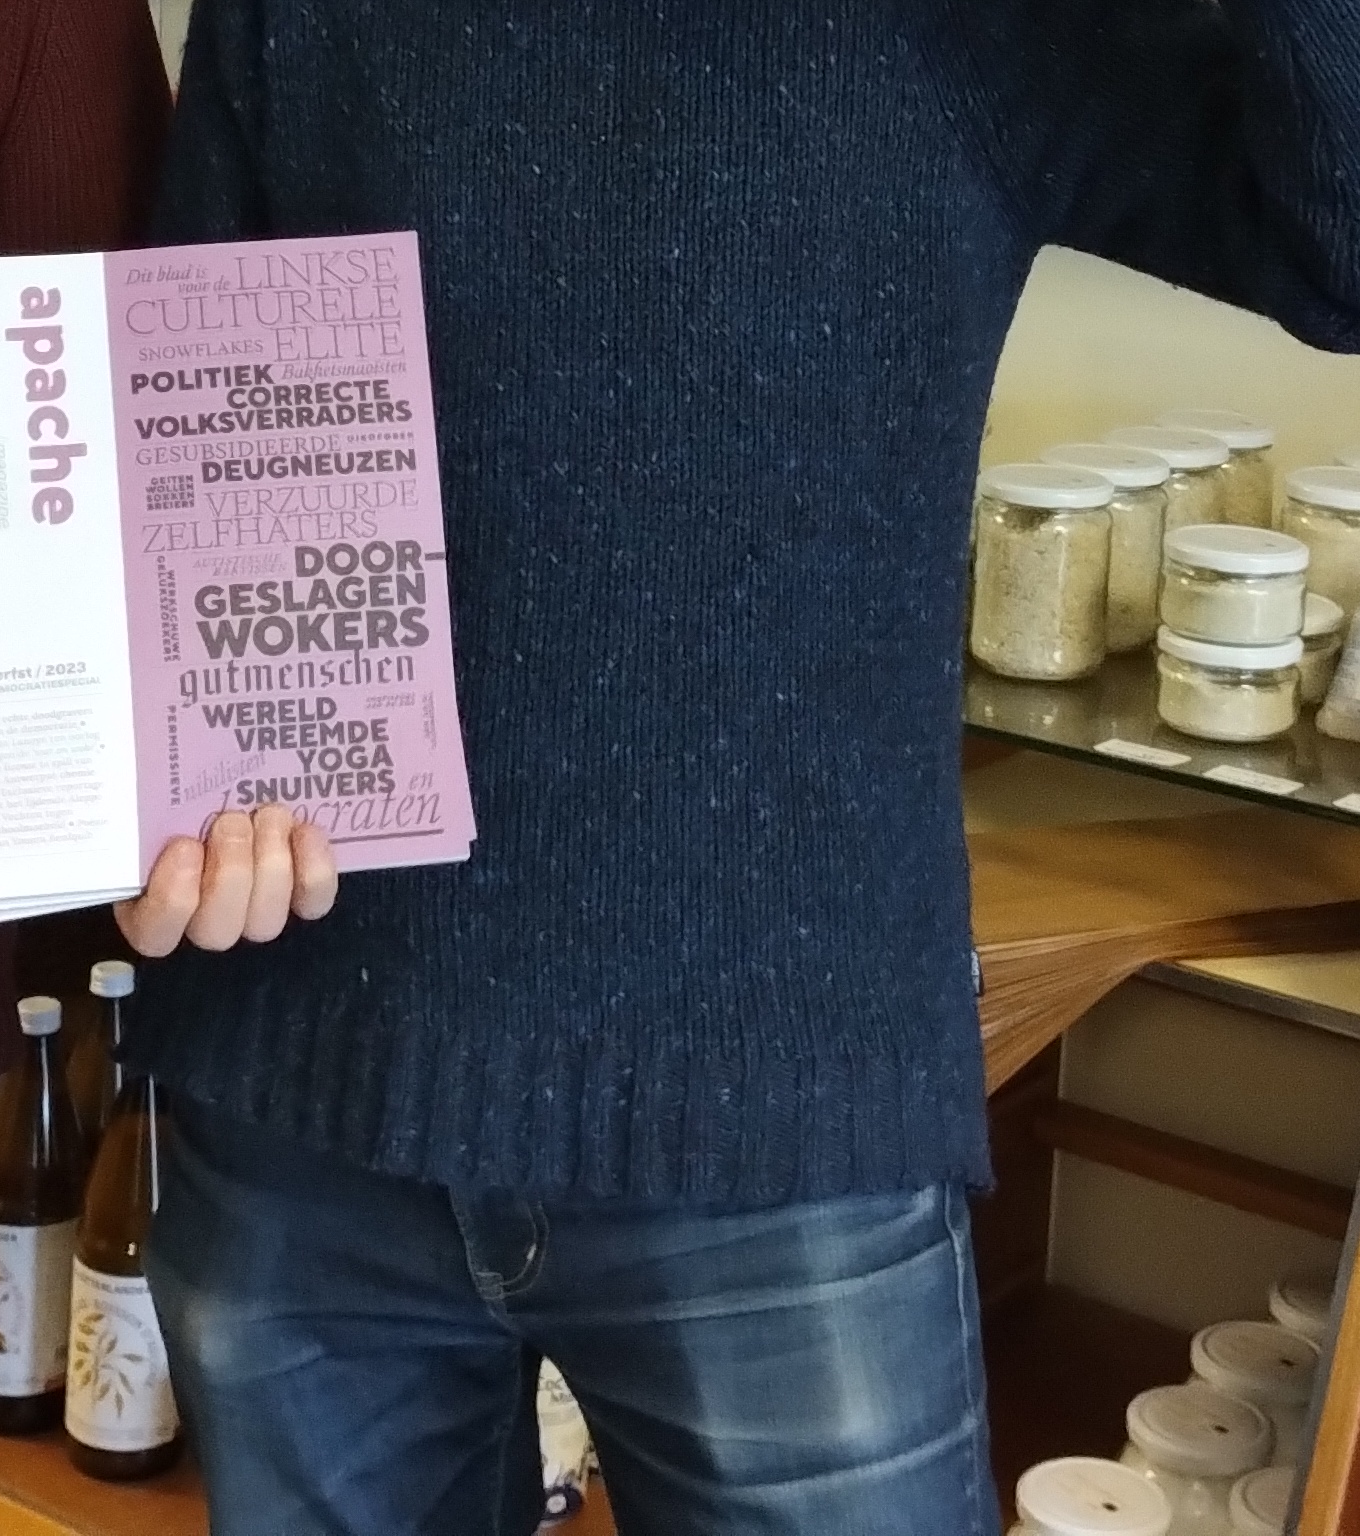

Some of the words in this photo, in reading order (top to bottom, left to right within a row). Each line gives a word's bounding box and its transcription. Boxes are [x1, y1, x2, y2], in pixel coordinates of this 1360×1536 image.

[126, 268, 152, 285] Dit
[157, 265, 191, 283] blad
[194, 266, 208, 280] is
[178, 280, 210, 294] voor
[213, 275, 231, 292] de
[235, 247, 400, 291] LINKSE
[126, 284, 402, 335] CULTURELE
[139, 339, 264, 362] SNOWFLAKES
[272, 320, 406, 362] ELITE
[130, 364, 276, 395] POLITIEK
[226, 379, 391, 410] CORRECTE
[4, 286, 88, 526] apache
[134, 400, 413, 439] VOLKSVERRADERS
[135, 434, 342, 466] GESUBSIDIEERDE
[201, 449, 417, 484] DEUGNEUZEN
[145, 483, 194, 493] WOLLEN
[204, 478, 419, 517] VERZUURDE
[142, 509, 378, 553] ZELFHATERS
[294, 539, 446, 578] DOOR-
[194, 573, 427, 619] GESLAGEN
[196, 607, 430, 660] WOKERS
[45, 661, 87, 677] 2023
[180, 649, 415, 708] gutmenschen
[201, 696, 338, 729] WERELD
[234, 717, 390, 753] VREEMDE
[167, 705, 181, 806] PERMISSIEVE
[296, 744, 395, 774] YOGA
[236, 769, 396, 806] SNUIVERS
[408, 772, 434, 792] en
